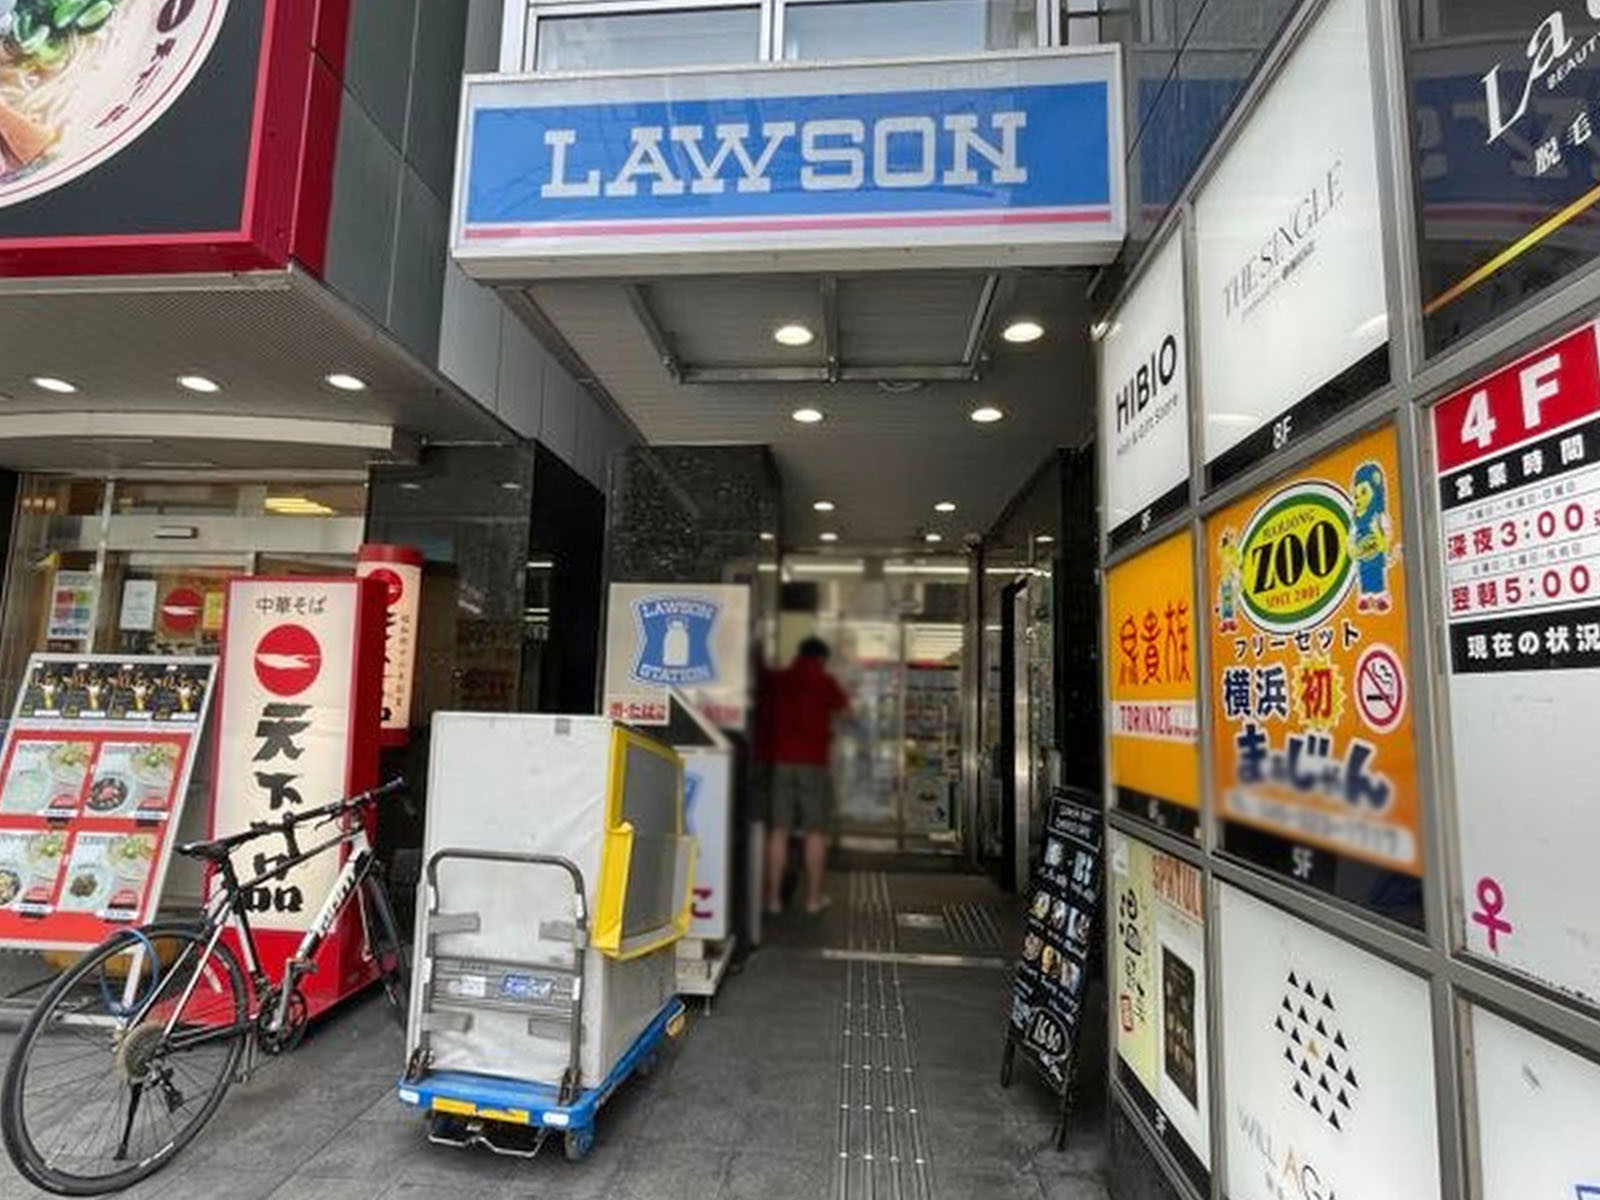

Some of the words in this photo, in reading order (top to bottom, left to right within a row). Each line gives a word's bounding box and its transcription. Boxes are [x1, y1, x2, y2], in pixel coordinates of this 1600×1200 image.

[1547, 32, 1600, 91] BEAUT
[541, 111, 1027, 197] LAWSON
[1116, 335, 1177, 433] HIBIO
[1272, 415, 1292, 450] 8F
[1252, 520, 1340, 594] ZOO
[256, 596, 327, 616] 中華そば
[642, 601, 716, 620] LAWSON
[1235, 622, 1358, 659] フリーセット
[1467, 622, 1600, 660] 現在の状況
